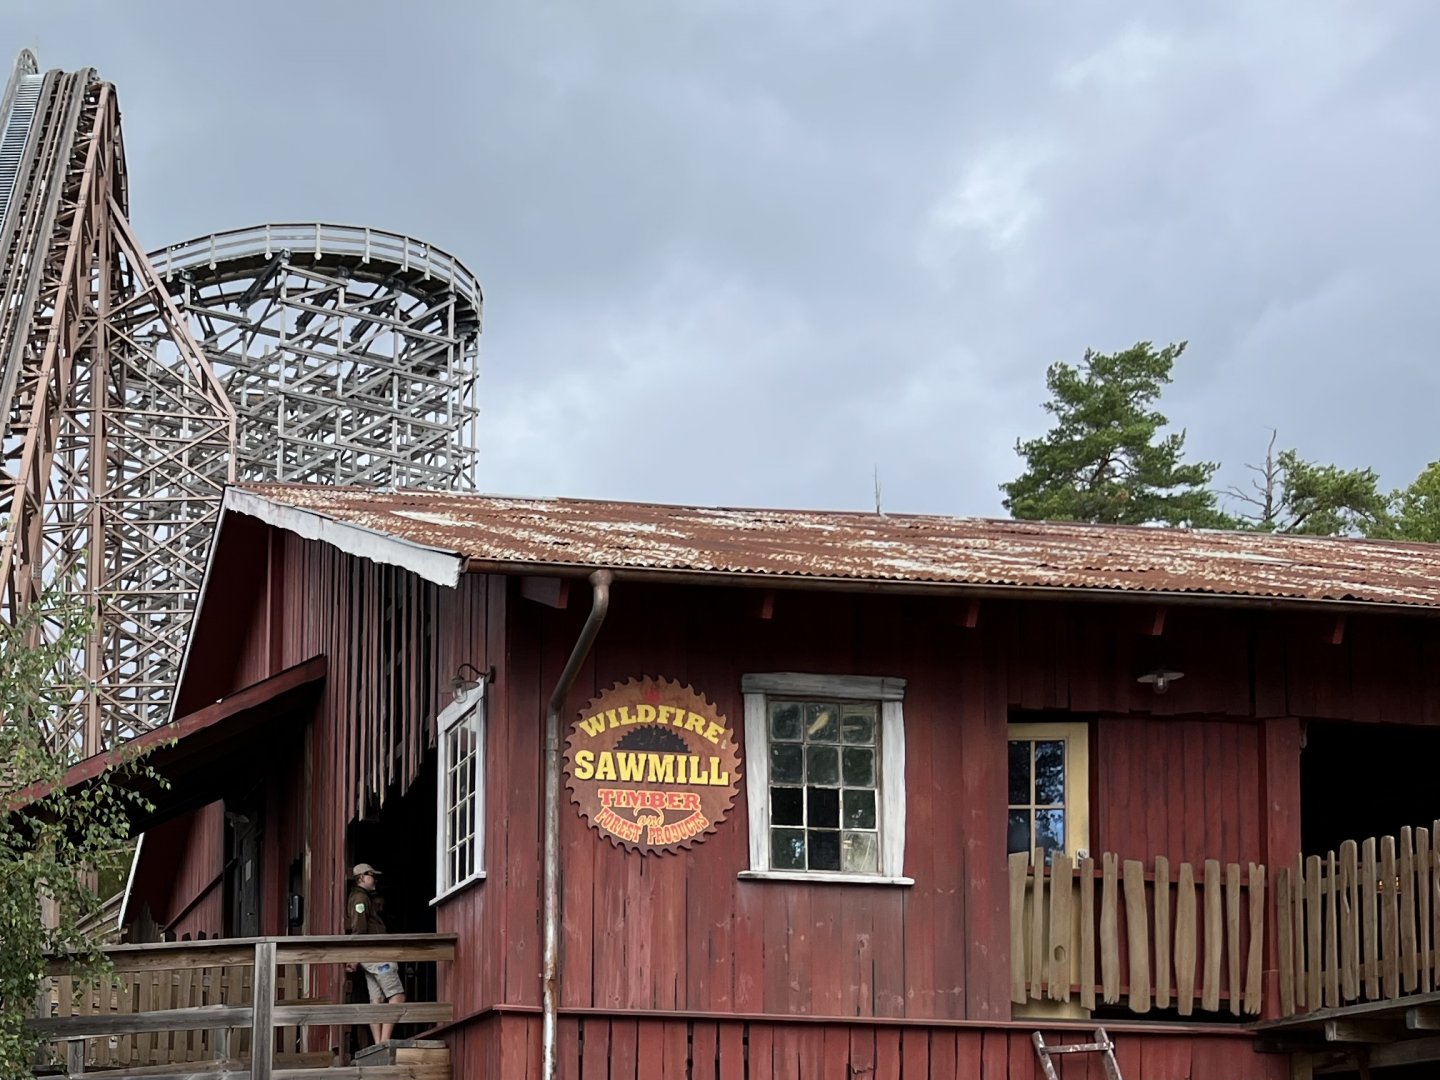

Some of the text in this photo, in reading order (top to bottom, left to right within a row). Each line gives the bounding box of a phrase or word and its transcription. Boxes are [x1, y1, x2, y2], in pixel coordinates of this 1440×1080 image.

[578, 704, 725, 744] WILDFIRE
[574, 750, 729, 786] SAWMILL
[598, 788, 701, 811] TIMBER
[633, 807, 665, 827] and
[594, 807, 710, 846] FOREST PRODUCTS
